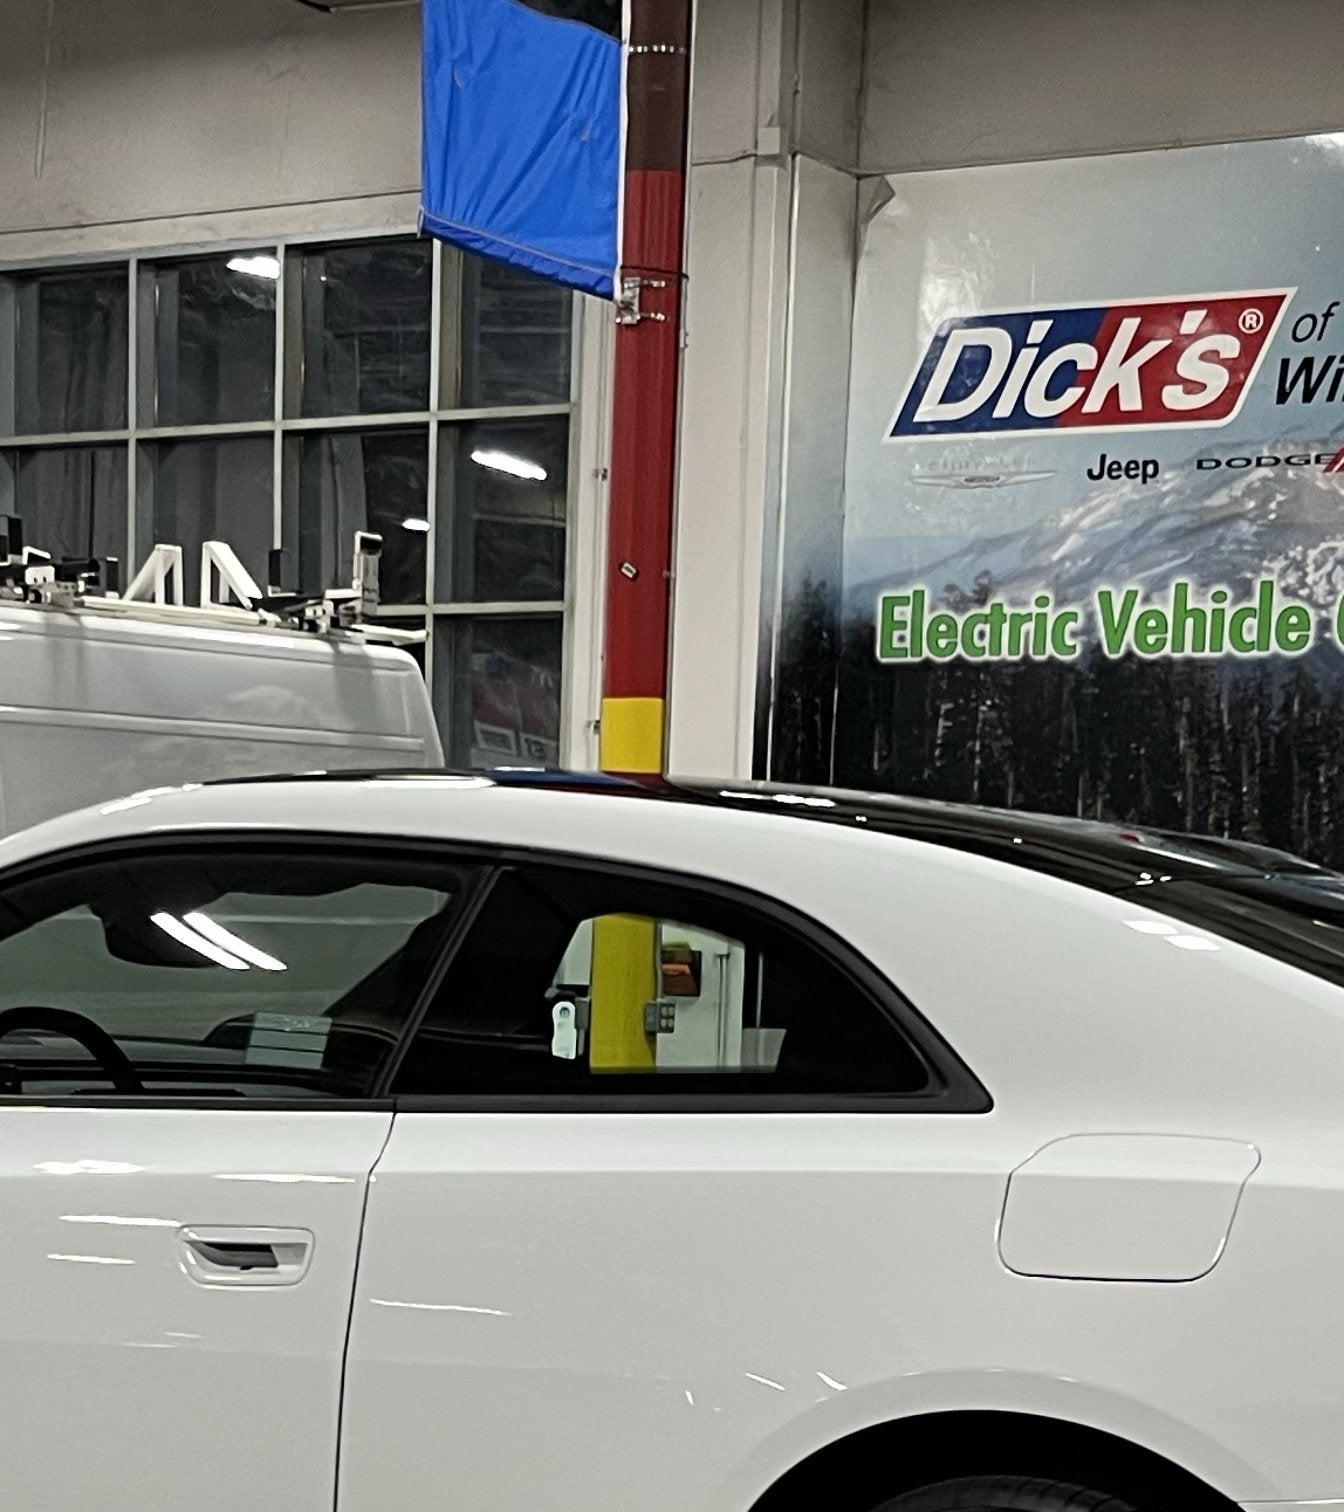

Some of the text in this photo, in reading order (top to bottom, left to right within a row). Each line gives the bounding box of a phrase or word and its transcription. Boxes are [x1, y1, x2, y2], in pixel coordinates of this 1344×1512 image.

[1292, 302, 1340, 343] of
[1087, 454, 1160, 484] Jeep
[1196, 453, 1333, 471] DODGE
[879, 588, 1079, 660] Electric
[1097, 580, 1311, 655] Vehicle
